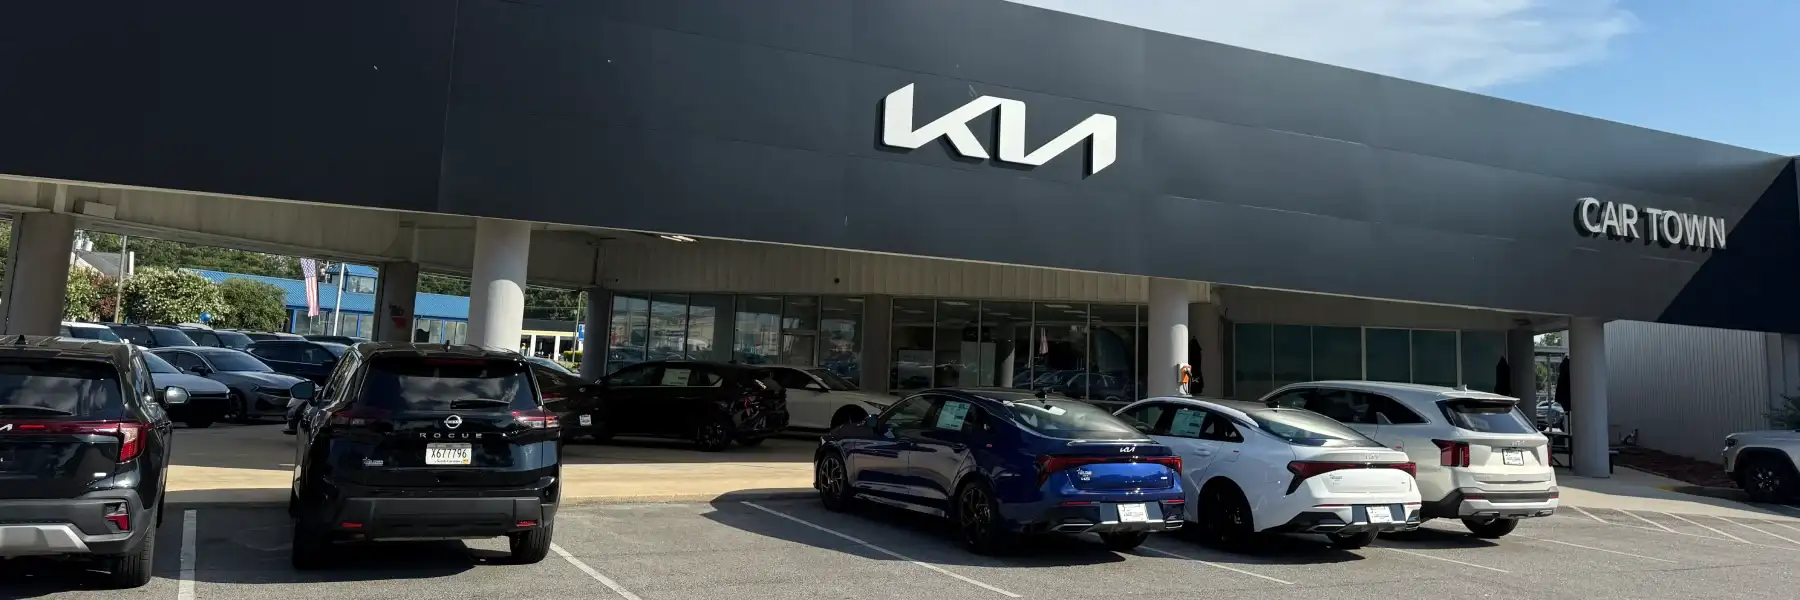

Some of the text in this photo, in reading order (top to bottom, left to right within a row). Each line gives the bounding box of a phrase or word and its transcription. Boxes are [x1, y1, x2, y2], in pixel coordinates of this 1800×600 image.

[1580, 197, 1726, 249] CAR TOWN
[431, 448, 467, 459] X677796
